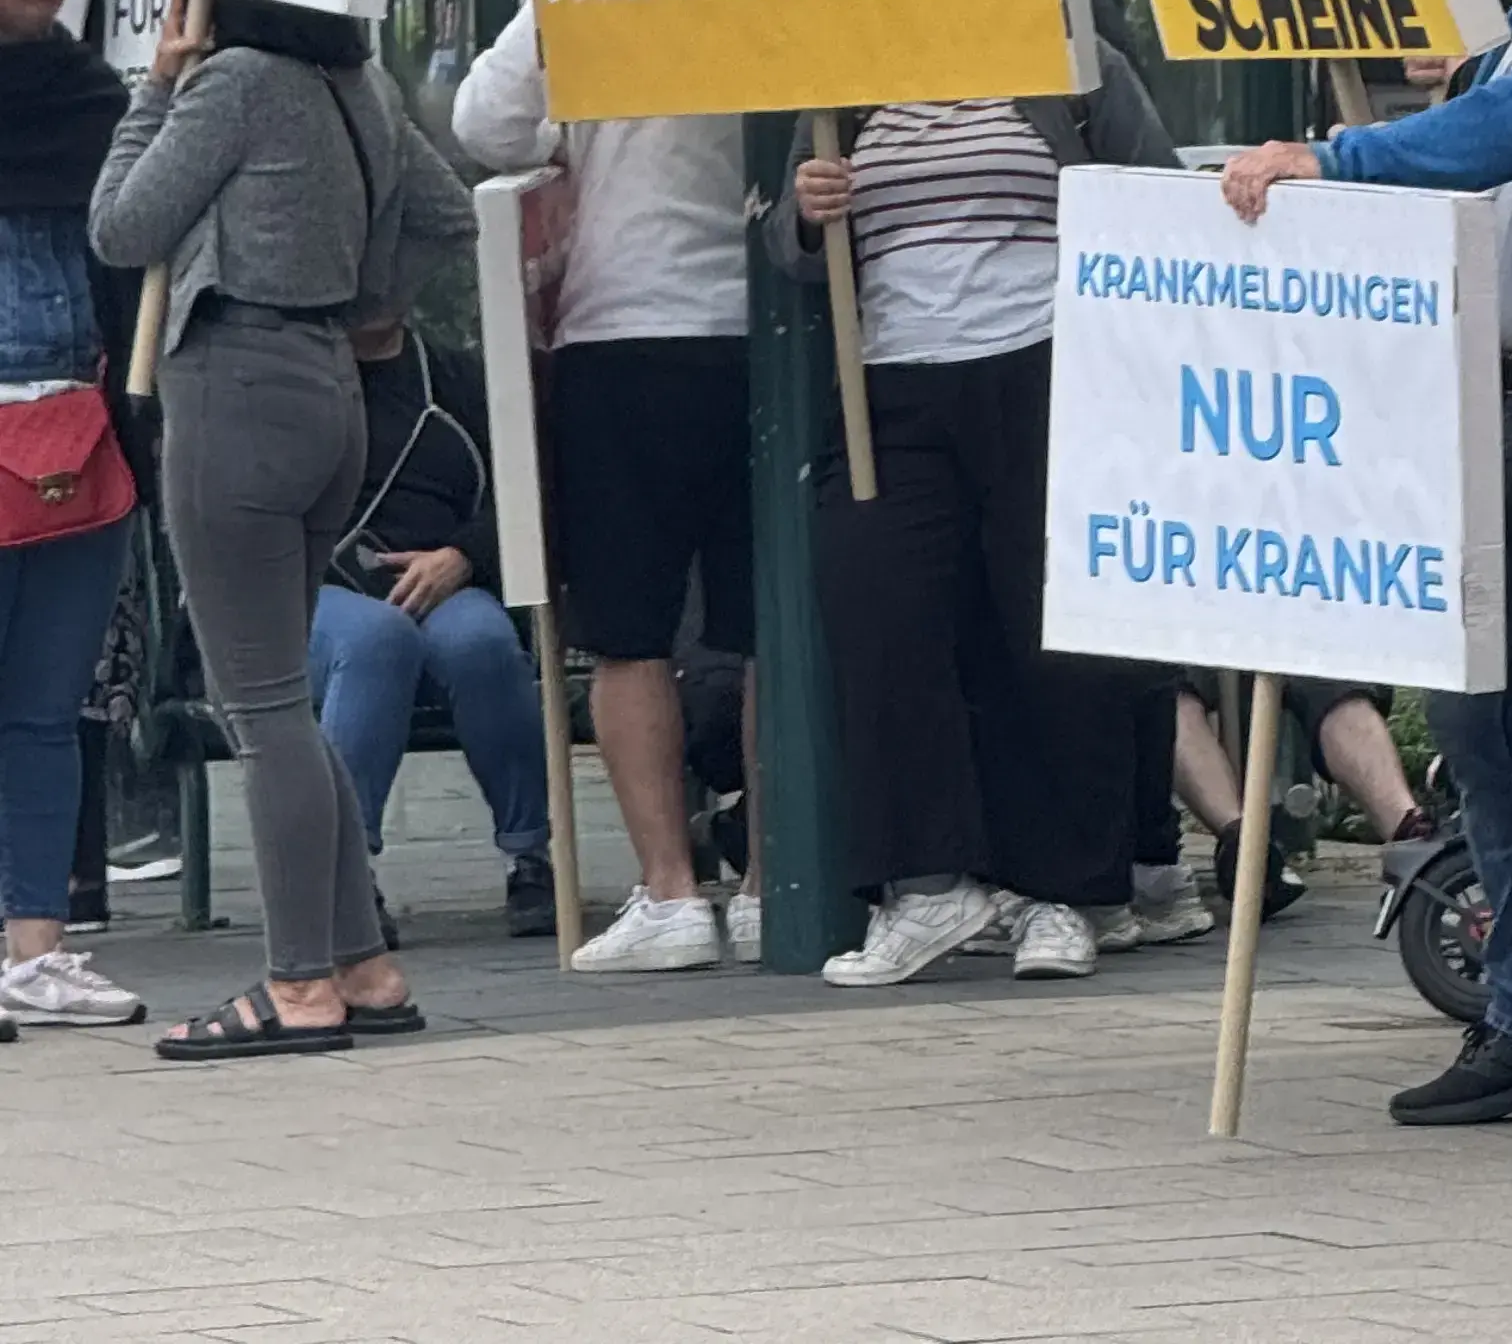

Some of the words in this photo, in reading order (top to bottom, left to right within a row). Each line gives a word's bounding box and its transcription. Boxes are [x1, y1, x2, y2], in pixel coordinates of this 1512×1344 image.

[1076, 251, 1439, 327] KRANKMELDUNGEN
[1179, 363, 1343, 467] NUR
[1087, 499, 1197, 588] FÜR
[1215, 525, 1449, 614] KRANKE
